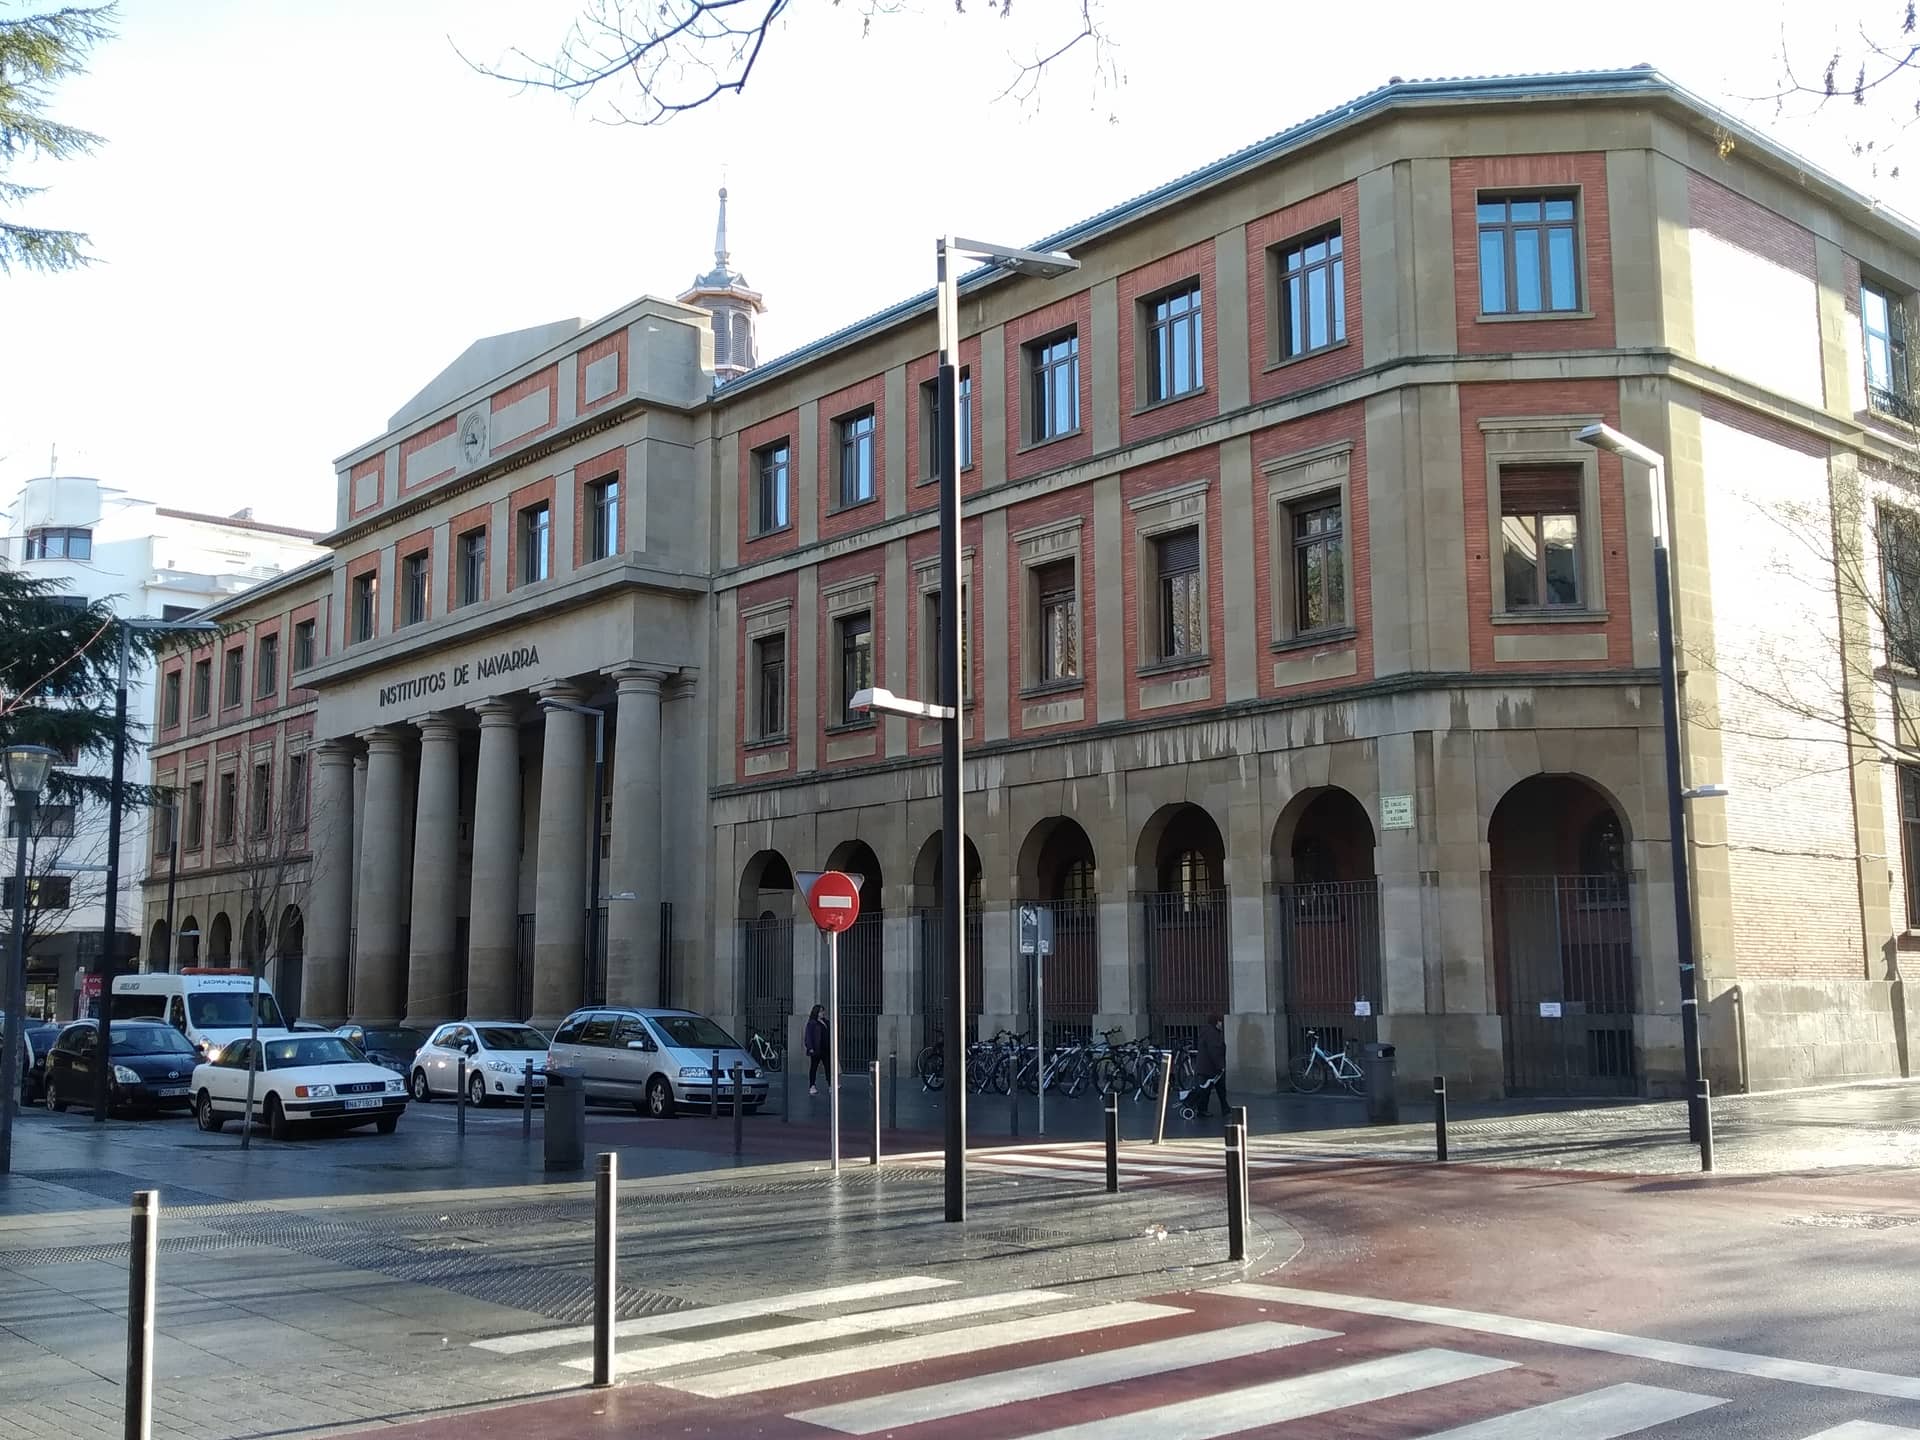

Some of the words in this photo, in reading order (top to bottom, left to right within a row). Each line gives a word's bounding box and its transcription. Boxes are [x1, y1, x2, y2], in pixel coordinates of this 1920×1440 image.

[379, 671, 446, 707] INSTITUTOS
[453, 663, 470, 687] DE
[477, 645, 540, 680] NAVARRA
